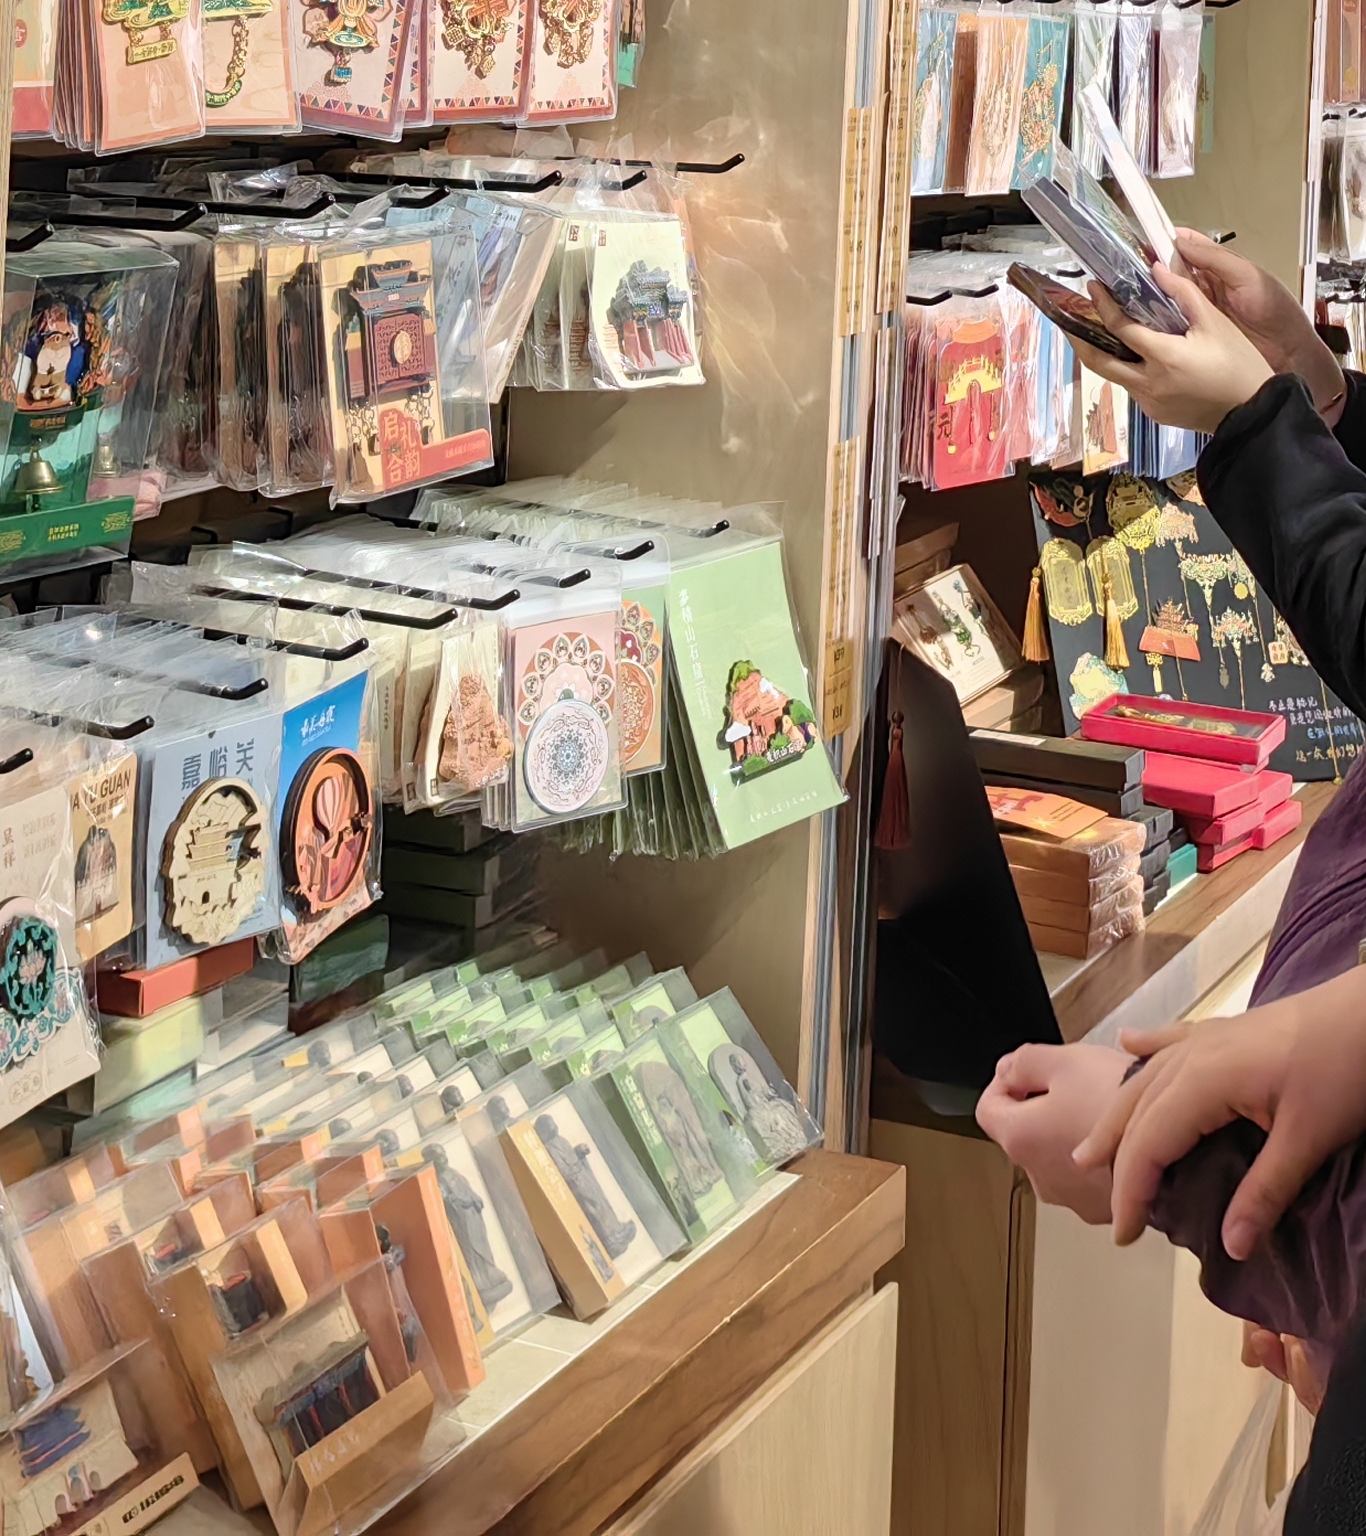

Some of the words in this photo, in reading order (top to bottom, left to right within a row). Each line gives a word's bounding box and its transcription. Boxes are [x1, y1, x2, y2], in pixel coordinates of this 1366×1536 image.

[100, 769, 131, 799] GUAN
[181, 737, 256, 790] 嘉峪关
